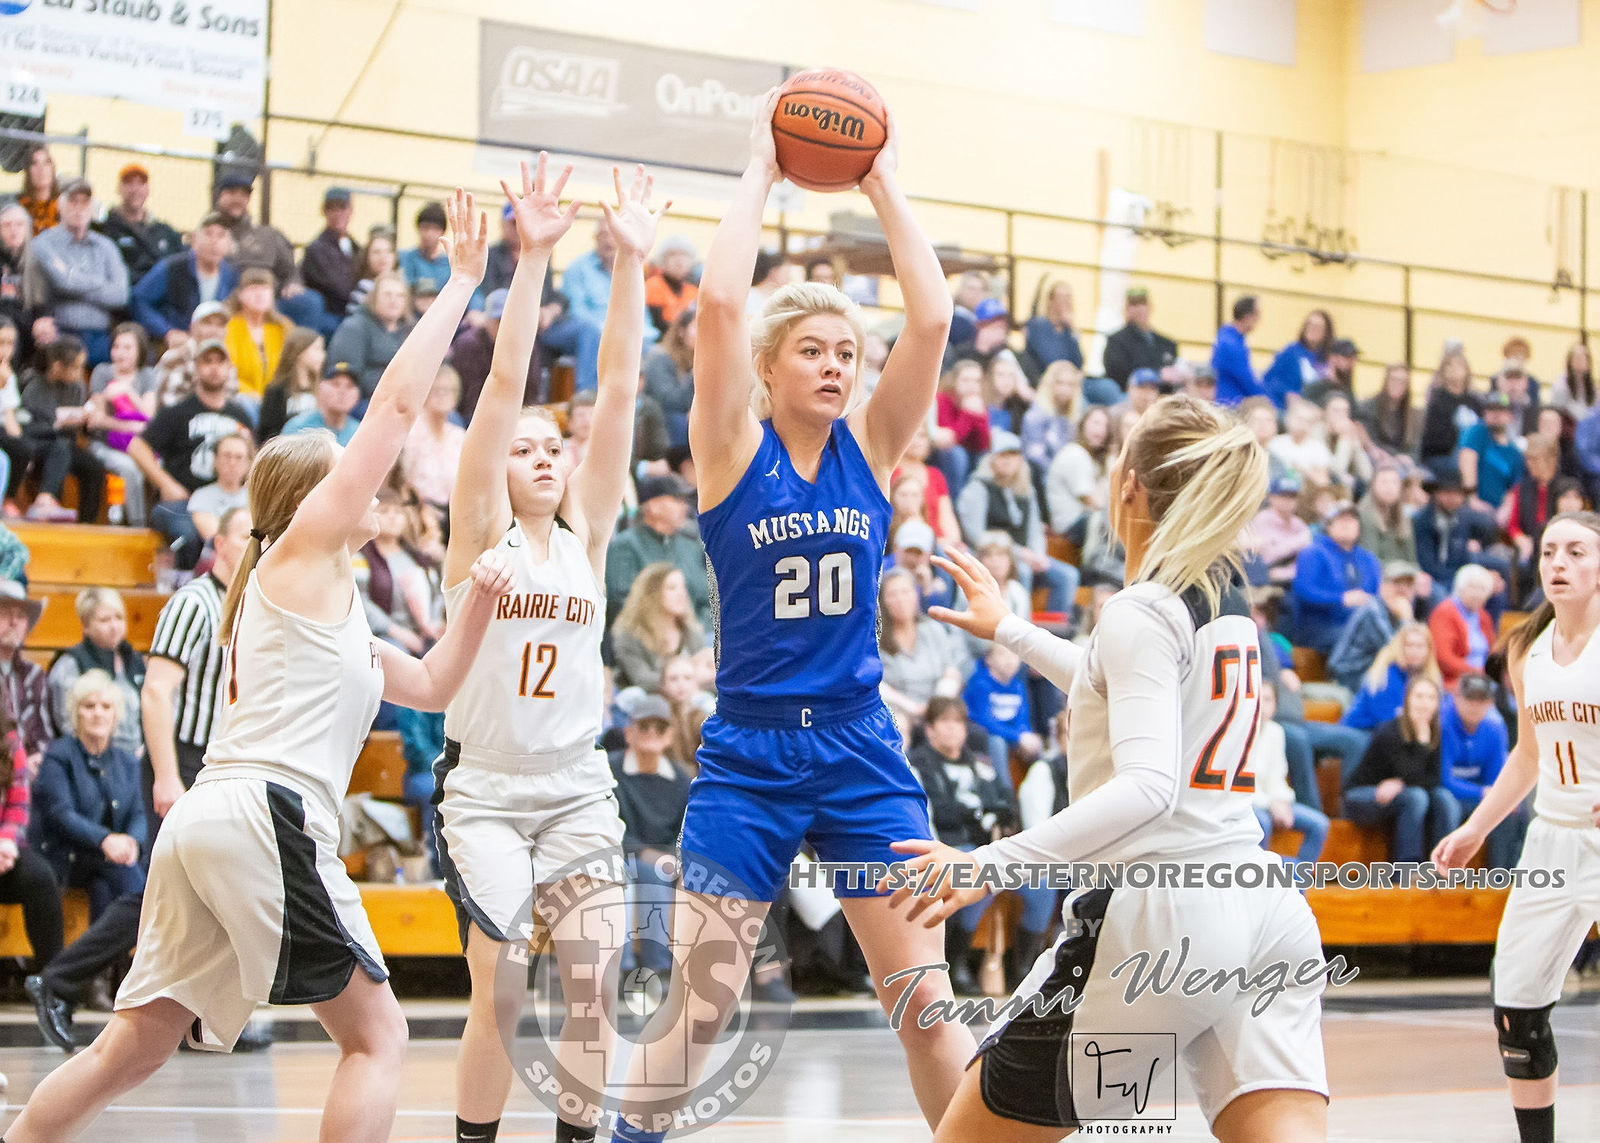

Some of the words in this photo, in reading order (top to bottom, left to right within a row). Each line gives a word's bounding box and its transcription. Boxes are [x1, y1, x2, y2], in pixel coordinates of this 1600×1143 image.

[170, 2, 189, 26] &
[198, 5, 260, 38] Sons
[510, 55, 609, 100] OSAA
[784, 102, 865, 141] Wilson
[747, 506, 870, 550] MUSTANGS
[774, 552, 853, 619] 20
[496, 593, 560, 620] RAIRIE
[566, 596, 596, 627] CITY
[519, 641, 558, 699] 12
[801, 707, 812, 728] C
[1189, 644, 1259, 793] 22
[1555, 741, 1580, 786] 11
